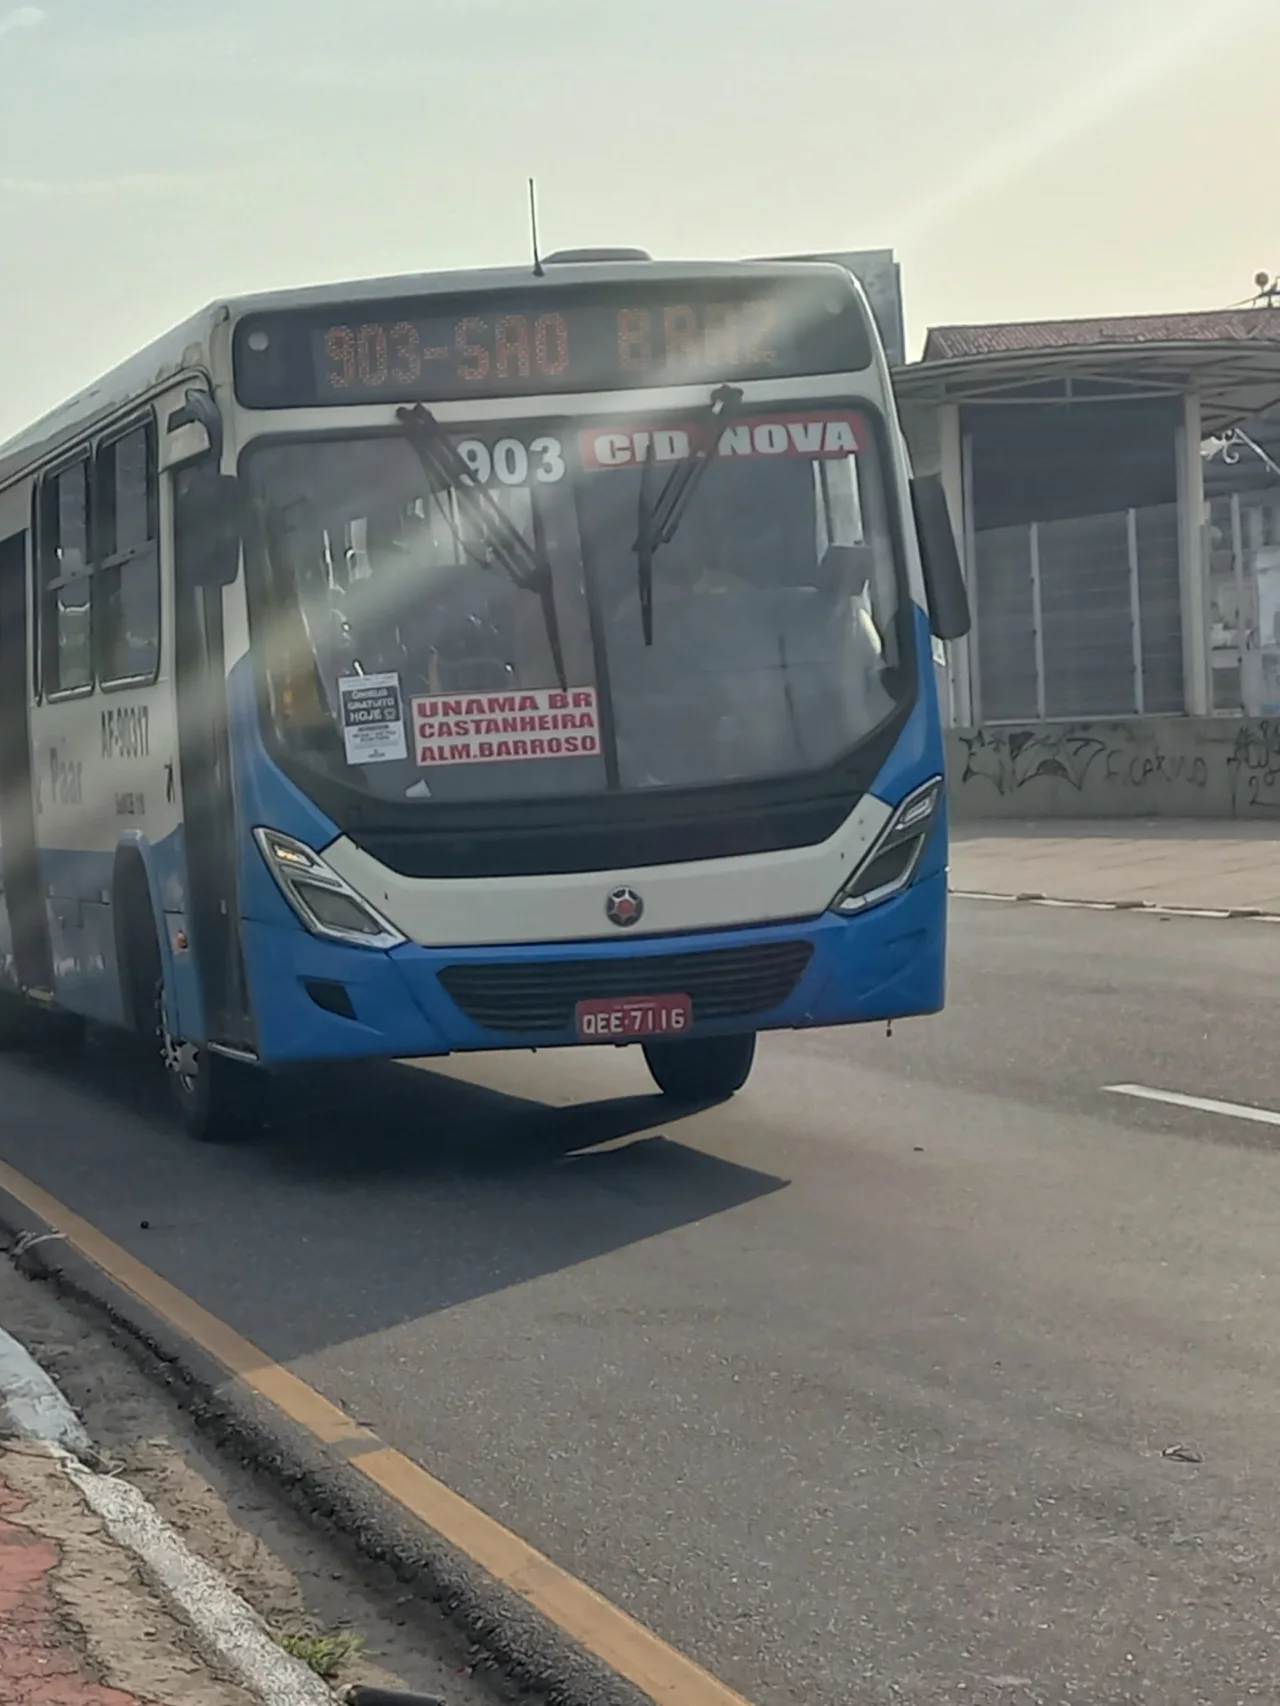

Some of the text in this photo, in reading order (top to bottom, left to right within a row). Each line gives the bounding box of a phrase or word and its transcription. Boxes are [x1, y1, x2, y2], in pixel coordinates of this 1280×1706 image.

[719, 421, 859, 456] NOVA
[457, 436, 565, 487] 903
[350, 709, 381, 722] HOJE
[417, 692, 593, 718] UNAMA BR
[419, 712, 595, 739] CASTANHEIRA
[420, 735, 597, 763] ALM.BARROSO
